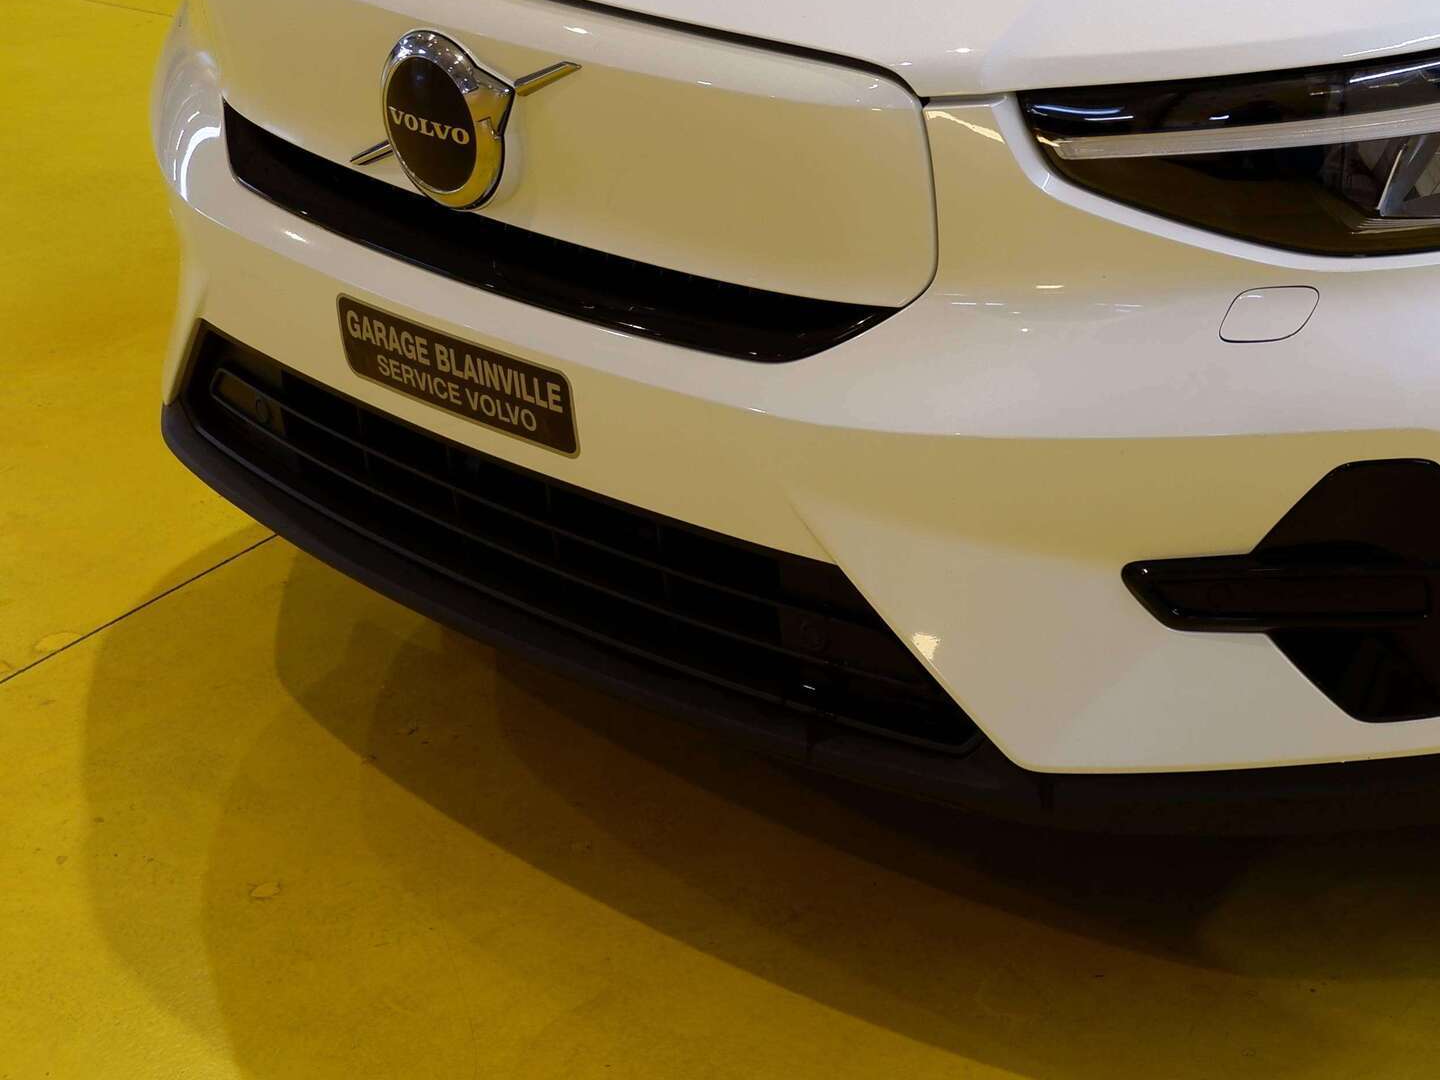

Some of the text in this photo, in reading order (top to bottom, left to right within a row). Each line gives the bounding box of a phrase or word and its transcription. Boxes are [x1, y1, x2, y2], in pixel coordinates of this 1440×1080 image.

[388, 106, 470, 145] VOLVO
[346, 310, 564, 414] GARAGE BLAINVILLE
[376, 354, 537, 432] SERVICE VOLVO
